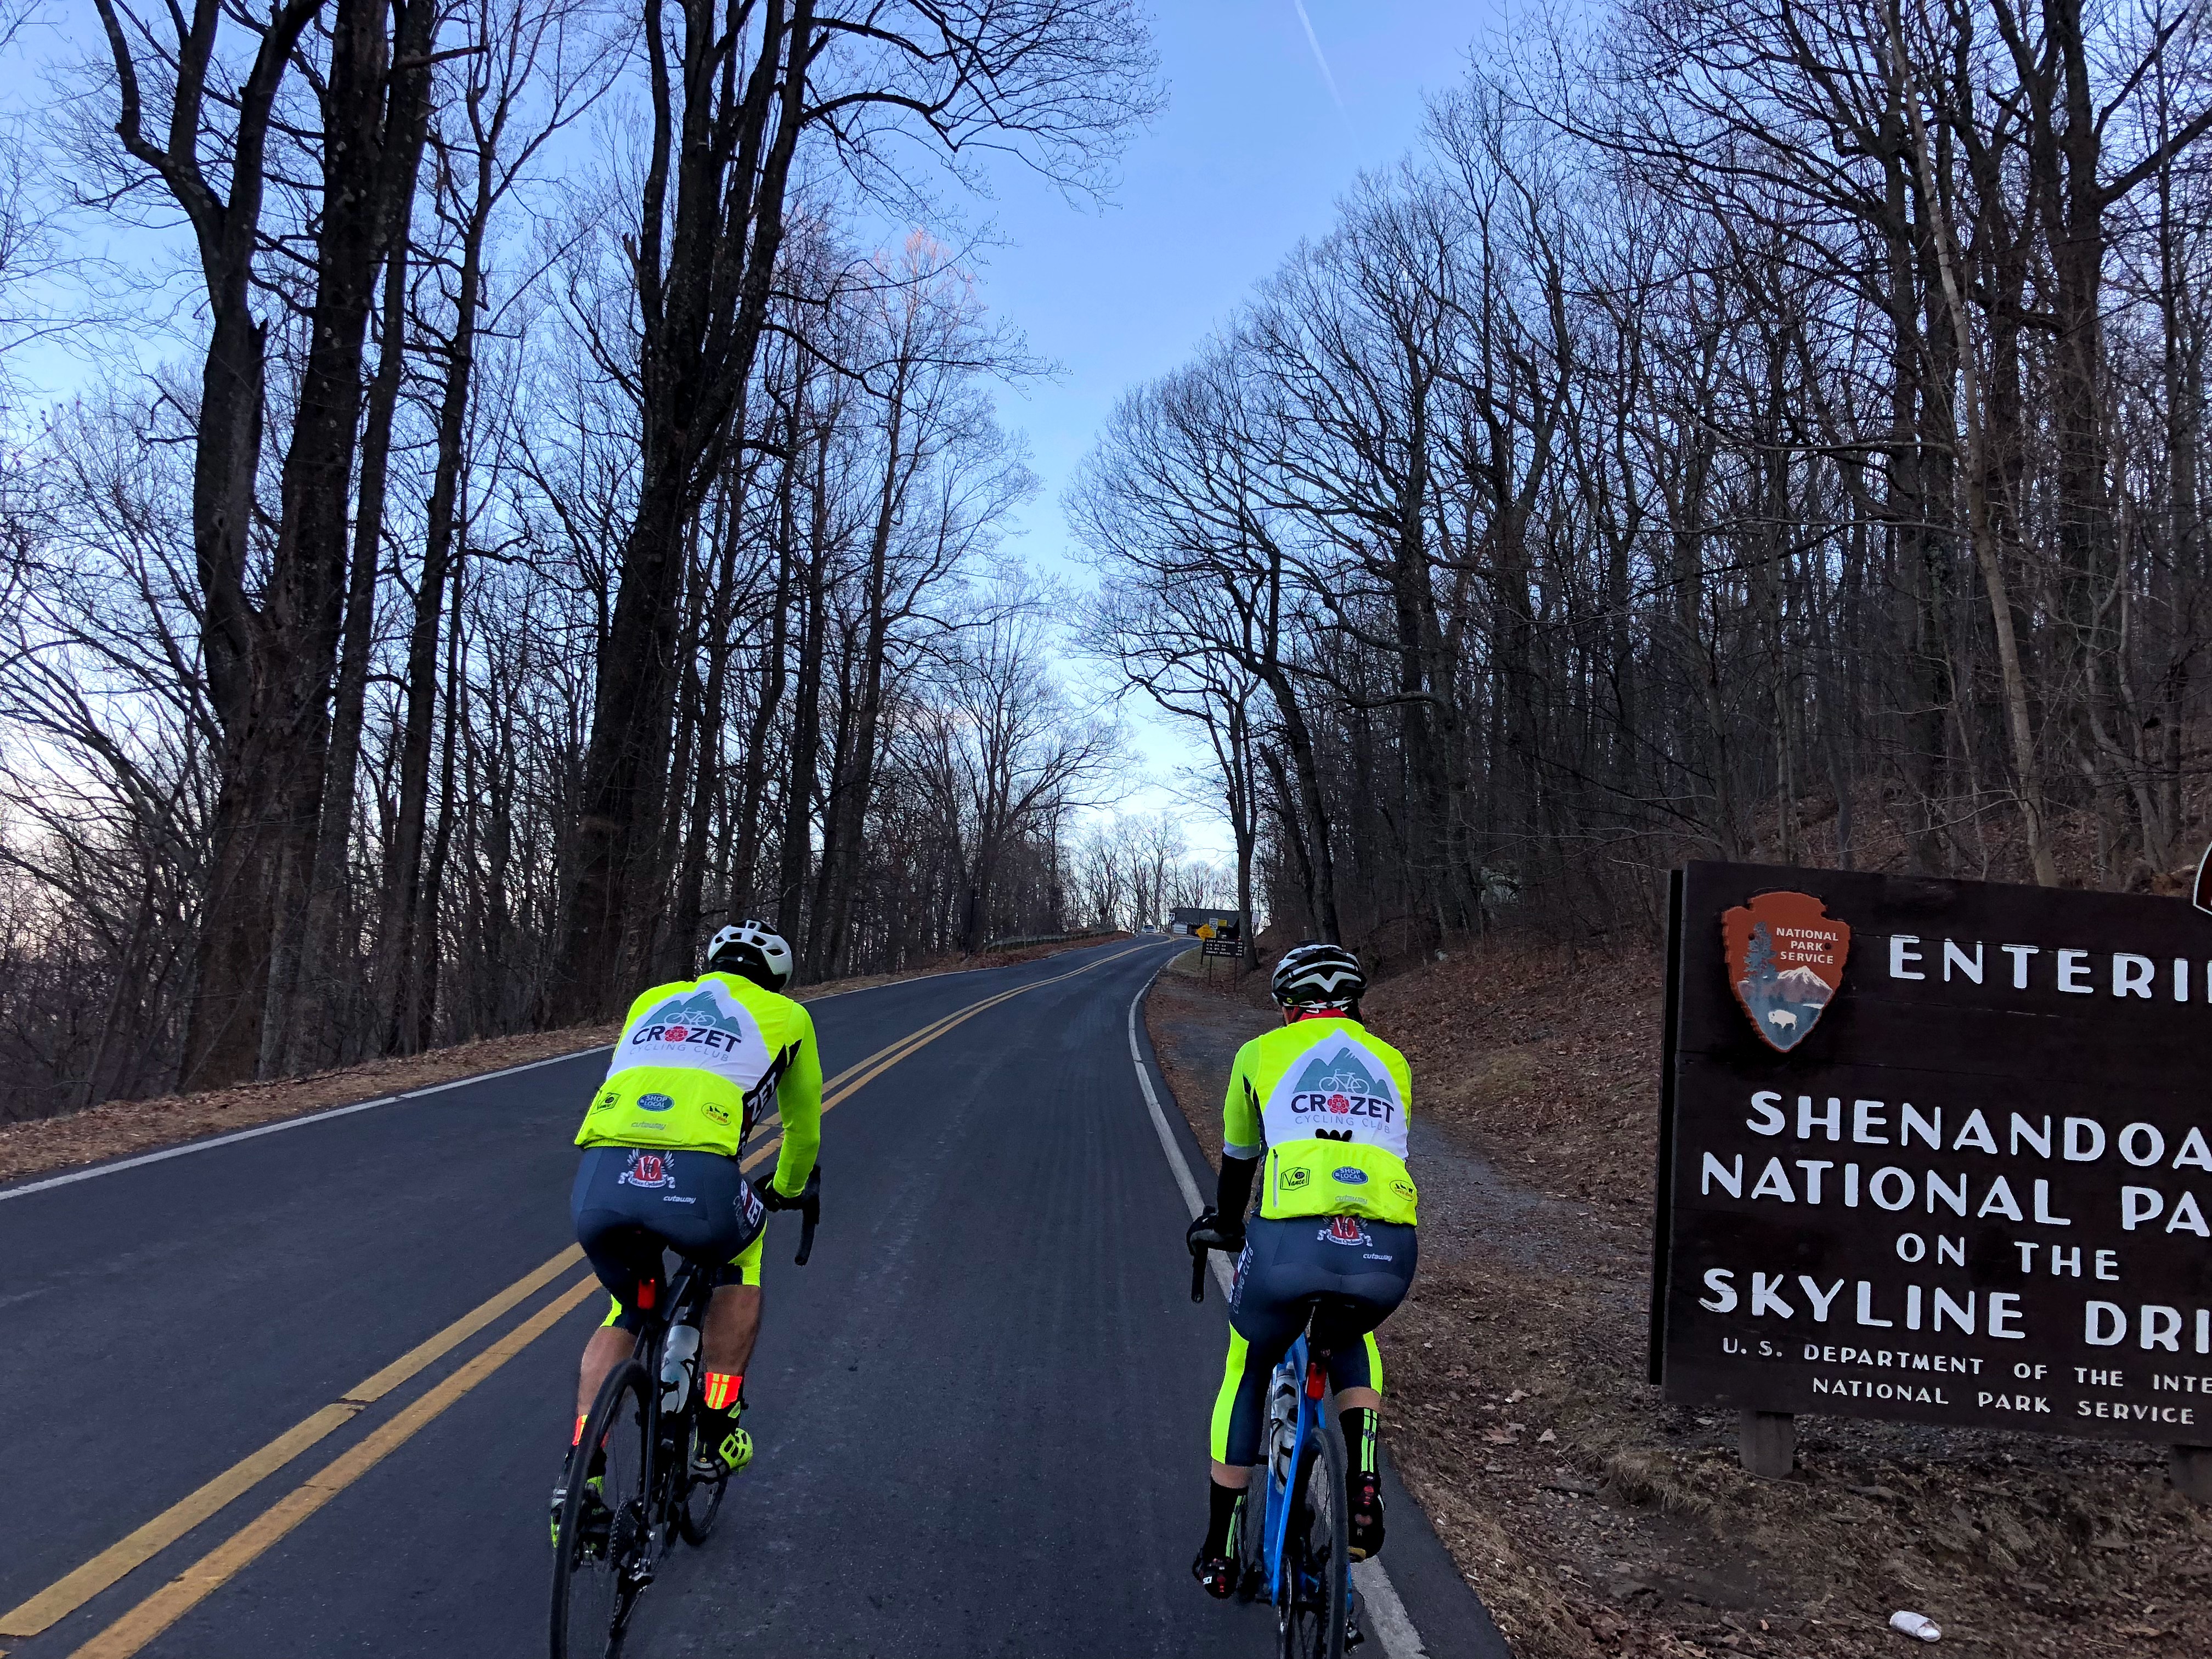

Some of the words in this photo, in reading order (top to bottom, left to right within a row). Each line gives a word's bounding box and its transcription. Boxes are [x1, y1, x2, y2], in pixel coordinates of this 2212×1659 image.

[1776, 927, 1838, 941] NATIONAL
[1791, 940, 1823, 951] PARK
[1780, 951, 1833, 964] SERVICE
[1889, 935, 2212, 1003] ENTERI
[630, 1043, 686, 1055] CYCLING
[694, 1046, 729, 1062] CLUB
[1295, 1115, 1355, 1126] CYCLING
[1362, 1118, 1390, 1134] CLUB
[1746, 1091, 2212, 1172] SHENANDOA
[663, 1195, 696, 1204] cutaway
[1702, 1152, 2071, 1225] NATIONAL
[2122, 1186, 2210, 1237] PA
[1363, 1253, 1393, 1261] cutaway
[1897, 1233, 1965, 1266] ON
[2014, 1242, 2119, 1280] THE
[1699, 1268, 2025, 1339] SKYLINE
[2085, 1301, 2210, 1353] DRI
[1804, 1344, 1984, 1374] DEPARTMENT
[2014, 1363, 2047, 1380] OF
[2074, 1367, 2124, 1387] THE
[2154, 1374, 2212, 1394] INTE
[1813, 1378, 1949, 1404] NATIONAL
[1978, 1392, 2051, 1413] PARK
[2078, 1401, 2194, 1425] SERVICE
